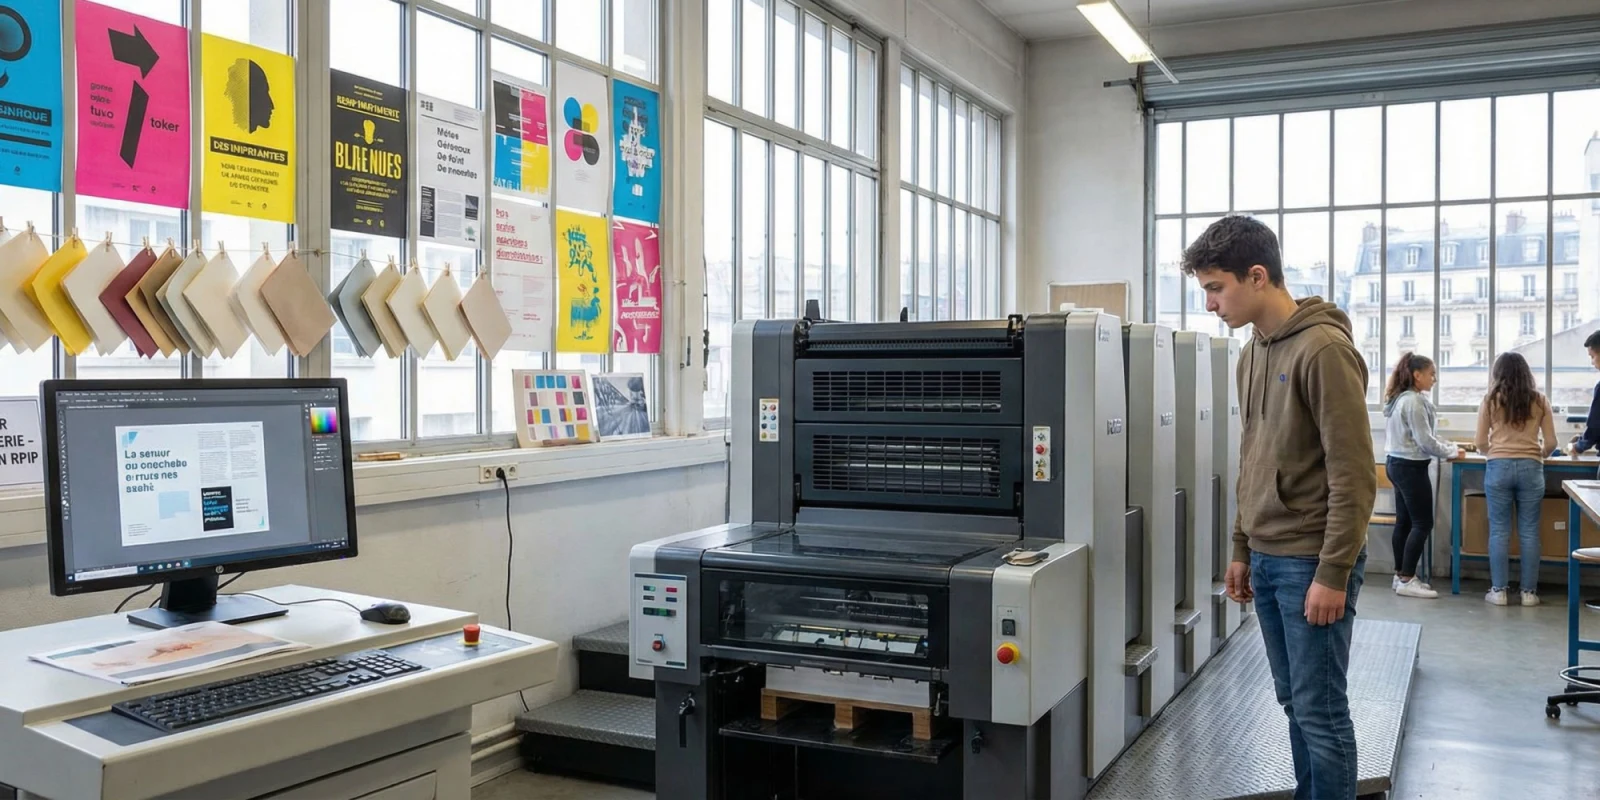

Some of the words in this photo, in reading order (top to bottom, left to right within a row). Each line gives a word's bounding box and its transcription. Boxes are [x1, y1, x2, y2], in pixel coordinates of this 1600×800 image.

[150, 117, 180, 132] toker
[10, 451, 39, 465] RPIP
[124, 449, 137, 459] La
[161, 471, 178, 480] nes
